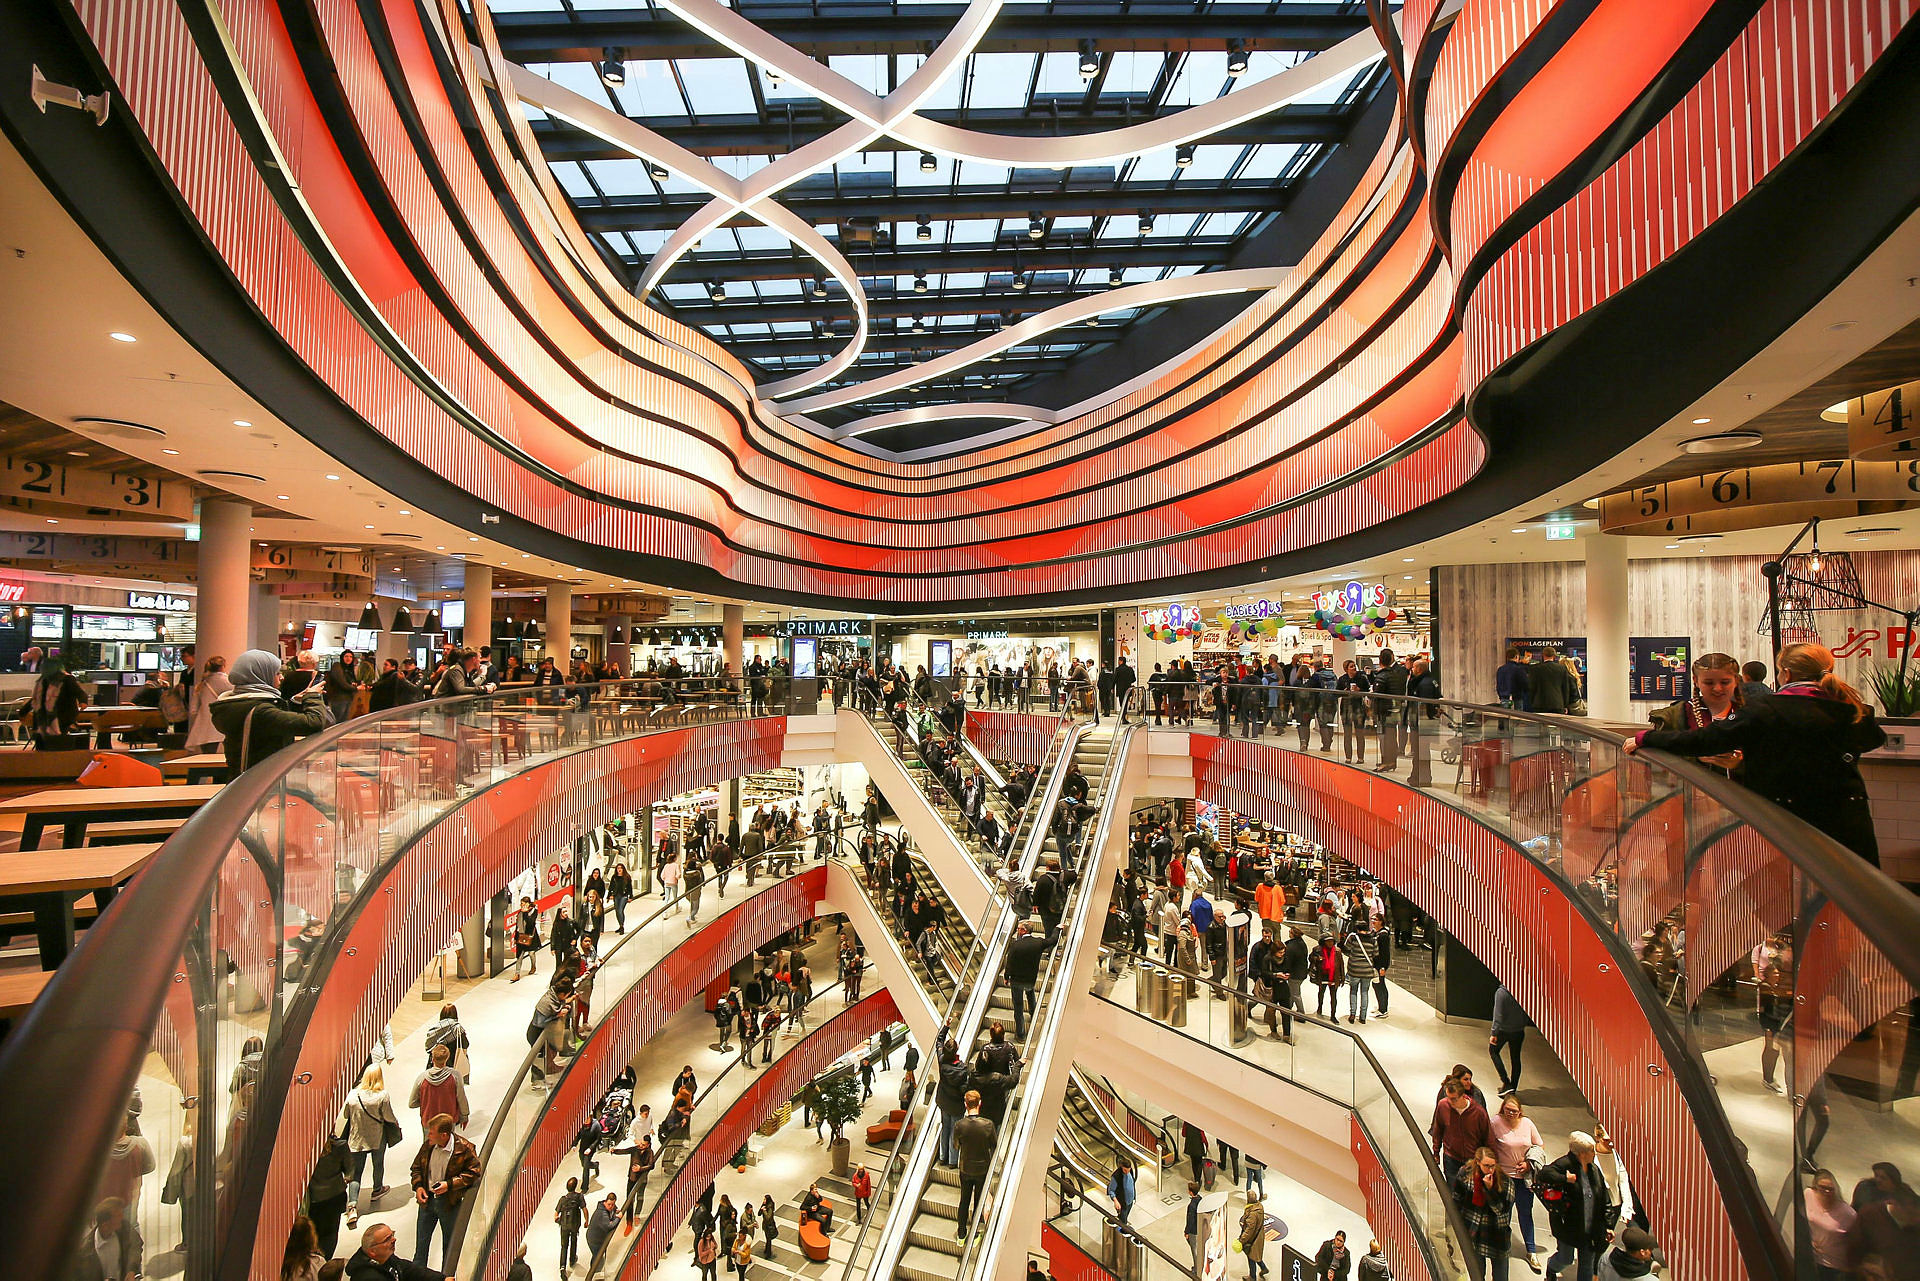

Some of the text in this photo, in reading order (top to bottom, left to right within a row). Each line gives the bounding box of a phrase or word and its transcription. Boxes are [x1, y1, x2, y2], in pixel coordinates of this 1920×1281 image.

[1874, 388, 1912, 434] 4
[21, 461, 150, 506] 2 3
[1640, 484, 1660, 516] 5
[1712, 470, 1740, 503] 6
[1815, 461, 1844, 494] 7
[26, 535, 170, 561] 2 3 4
[269, 549, 370, 574] 6 7 8
[787, 621, 861, 635] PRIMARK
[967, 631, 1008, 640] PRIMARK
[1161, 1193, 1182, 1206] EG
